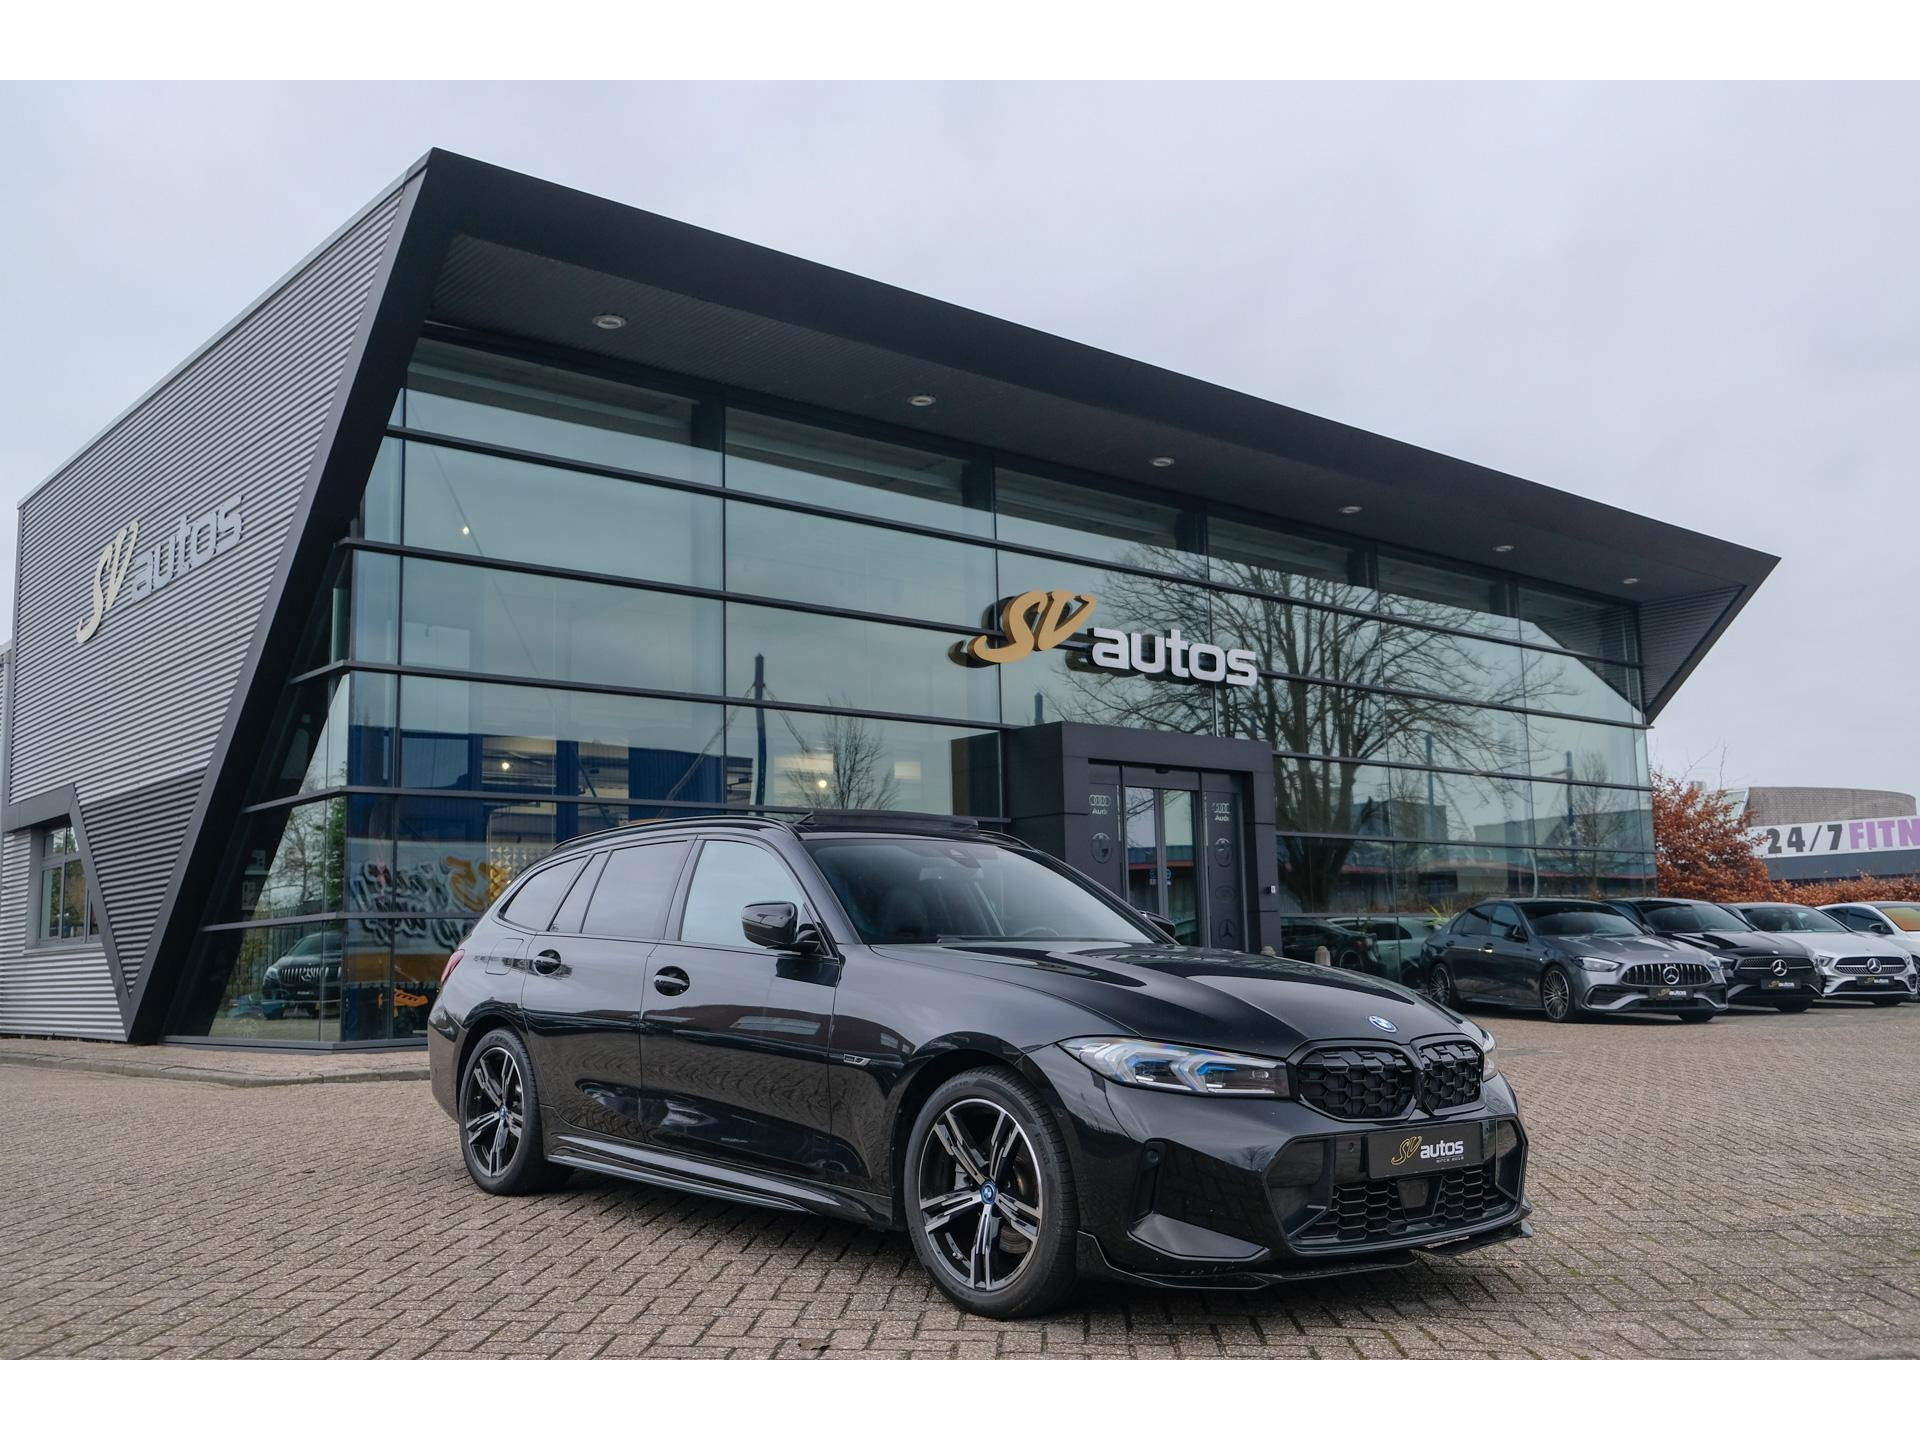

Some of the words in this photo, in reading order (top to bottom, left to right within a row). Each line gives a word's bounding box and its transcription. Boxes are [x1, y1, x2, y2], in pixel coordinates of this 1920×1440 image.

[130, 494, 242, 601] autos
[1092, 627, 1259, 686] autos
[1766, 823, 1842, 854] 24/7
[1849, 818, 1920, 849] FITN
[1420, 1140, 1464, 1159] autos
